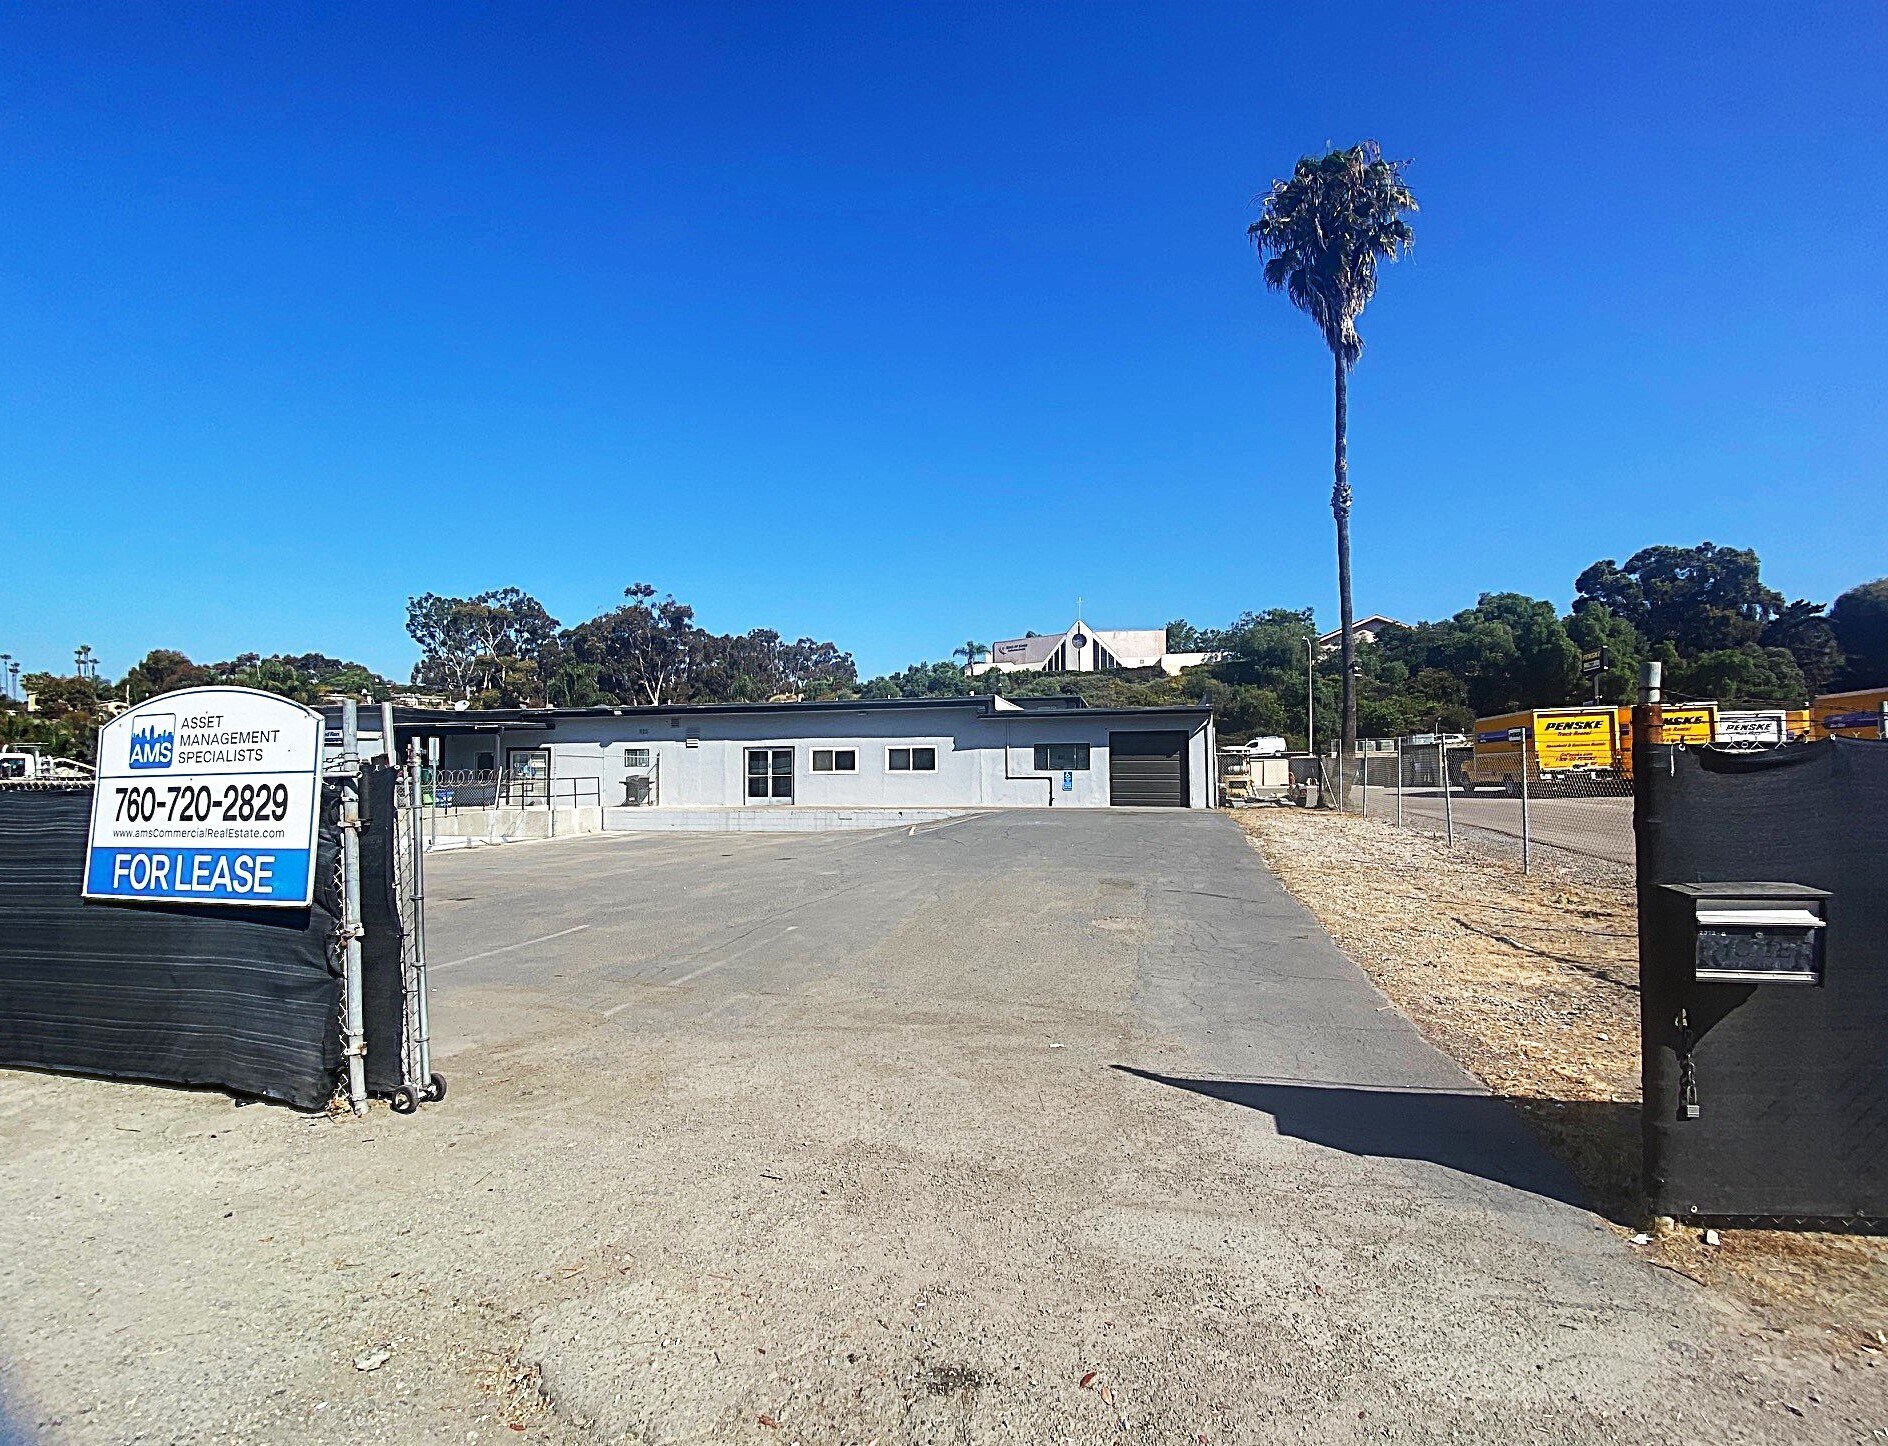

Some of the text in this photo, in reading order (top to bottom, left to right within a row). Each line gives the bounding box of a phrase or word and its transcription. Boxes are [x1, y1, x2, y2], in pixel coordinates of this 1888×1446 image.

[181, 716, 224, 729] ASSET
[1545, 720, 1604, 731] PENSKE
[1663, 716, 1704, 726] NSKE
[1726, 723, 1772, 732] PENSKE
[179, 730, 280, 747] MANAGEMENT
[129, 742, 172, 763] AMS
[178, 749, 263, 764] SPECIALISTS
[115, 783, 288, 823] 760-720-2829
[113, 828, 285, 839] www.amsCommercialRealEstate.com
[113, 853, 275, 893] FOR LEASE
